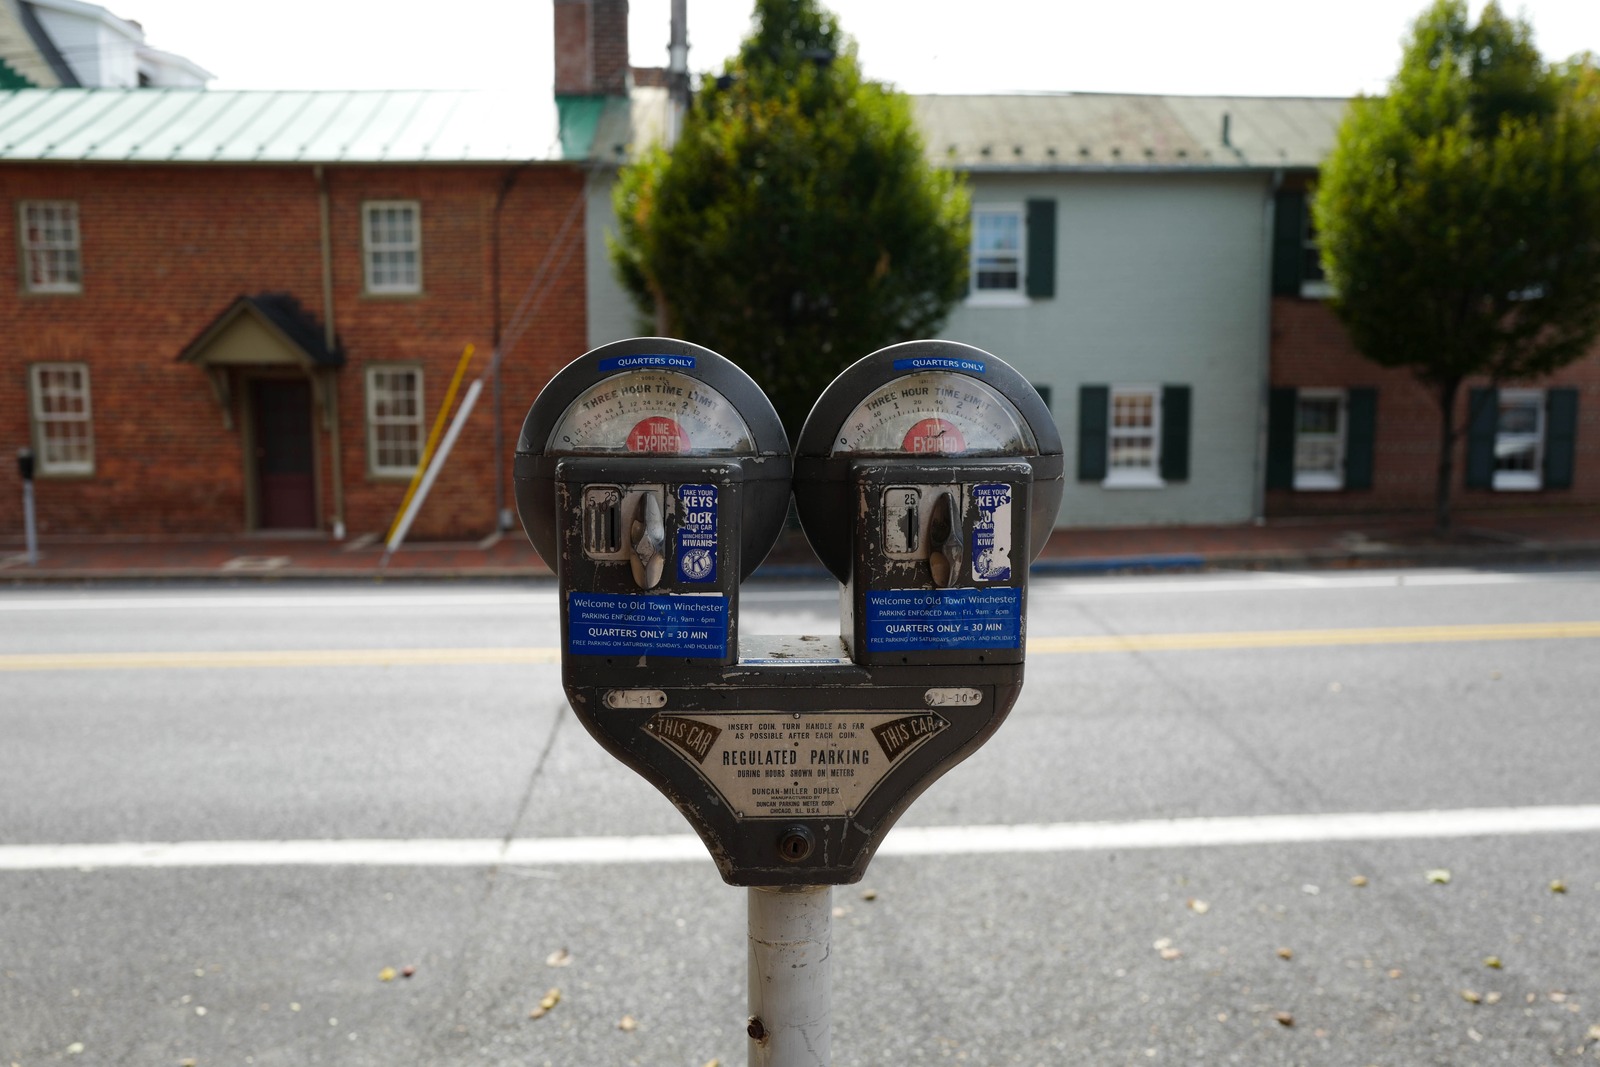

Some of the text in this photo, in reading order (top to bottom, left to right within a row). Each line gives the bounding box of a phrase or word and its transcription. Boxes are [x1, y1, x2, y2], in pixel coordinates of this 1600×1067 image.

[618, 358, 692, 366] QUARTERS ONLY
[962, 362, 984, 371] ONLY
[583, 390, 618, 410] THREE
[621, 385, 651, 396] HOUR
[655, 385, 682, 396] TIME
[865, 392, 897, 411] THREE
[902, 387, 929, 398] HOUR
[935, 388, 960, 399] TIME
[682, 401, 688, 409] 2
[649, 423, 669, 435] TIME
[637, 436, 681, 452] EXPIRED
[914, 436, 957, 452] EXPIRED
[590, 497, 595, 507] 5
[605, 491, 617, 502] 25
[684, 496, 713, 508] KEYS
[904, 494, 916, 505] 25
[978, 496, 1006, 507] KEYS
[574, 599, 615, 608] Welcome
[630, 601, 645, 610] Old
[649, 602, 671, 611] Town
[674, 603, 724, 612] Winchester
[871, 597, 911, 606] Welcome
[926, 596, 941, 604] Old
[968, 596, 1016, 604] Winchester
[588, 628, 637, 637] QUARTERS
[640, 630, 664, 638] ONLY
[885, 625, 934, 634] QUARTERS
[657, 718, 713, 757] THIS CAR
[880, 716, 935, 752] THIS CAR
[722, 750, 869, 766] REGULATED PARKING
[830, 769, 854, 777] METERS
